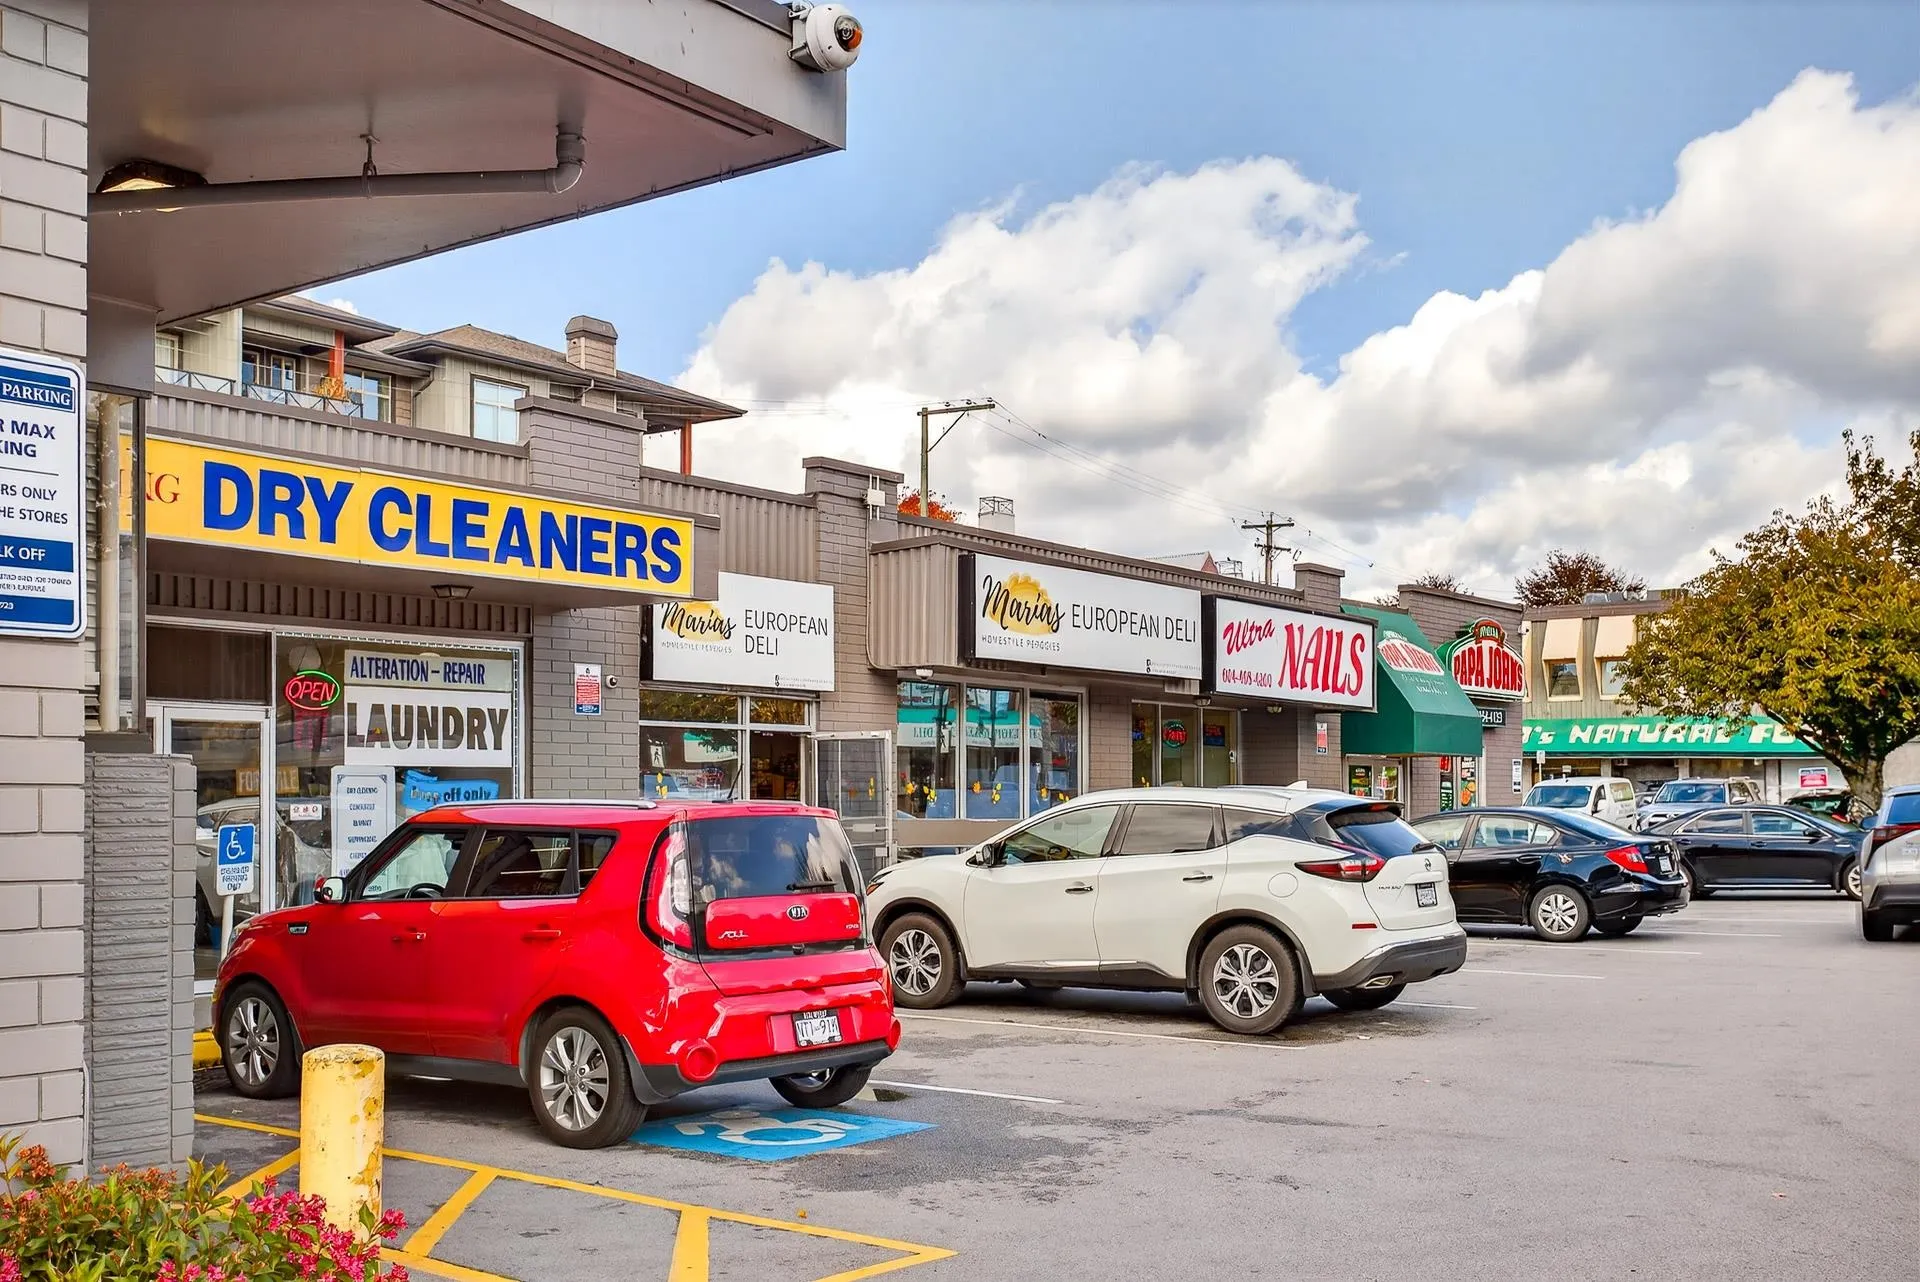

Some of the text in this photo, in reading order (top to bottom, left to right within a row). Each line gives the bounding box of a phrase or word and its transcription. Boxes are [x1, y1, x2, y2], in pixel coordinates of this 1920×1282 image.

[2, 382, 71, 406] PARKING
[11, 420, 56, 440] MAX
[21, 486, 58, 501] ONLY
[19, 508, 69, 525] STORES
[202, 460, 683, 584] DRY CLEANERS
[18, 547, 46, 562] OFF
[744, 609, 829, 637] EUROPEAN
[1072, 603, 1160, 638] EUROPEAN
[1165, 616, 1196, 643] DELI
[744, 634, 778, 656] DELI
[1223, 618, 1275, 656] Ultra
[1278, 622, 1366, 697] NAILS
[1453, 644, 1485, 688] PAPA
[350, 655, 429, 682] ALTERATION
[443, 661, 485, 685] REPAIR
[288, 680, 335, 702] OPEN
[346, 702, 509, 751] LAUNDRY
[1568, 722, 1731, 745] NATURAL
[443, 786, 461, 802] off
